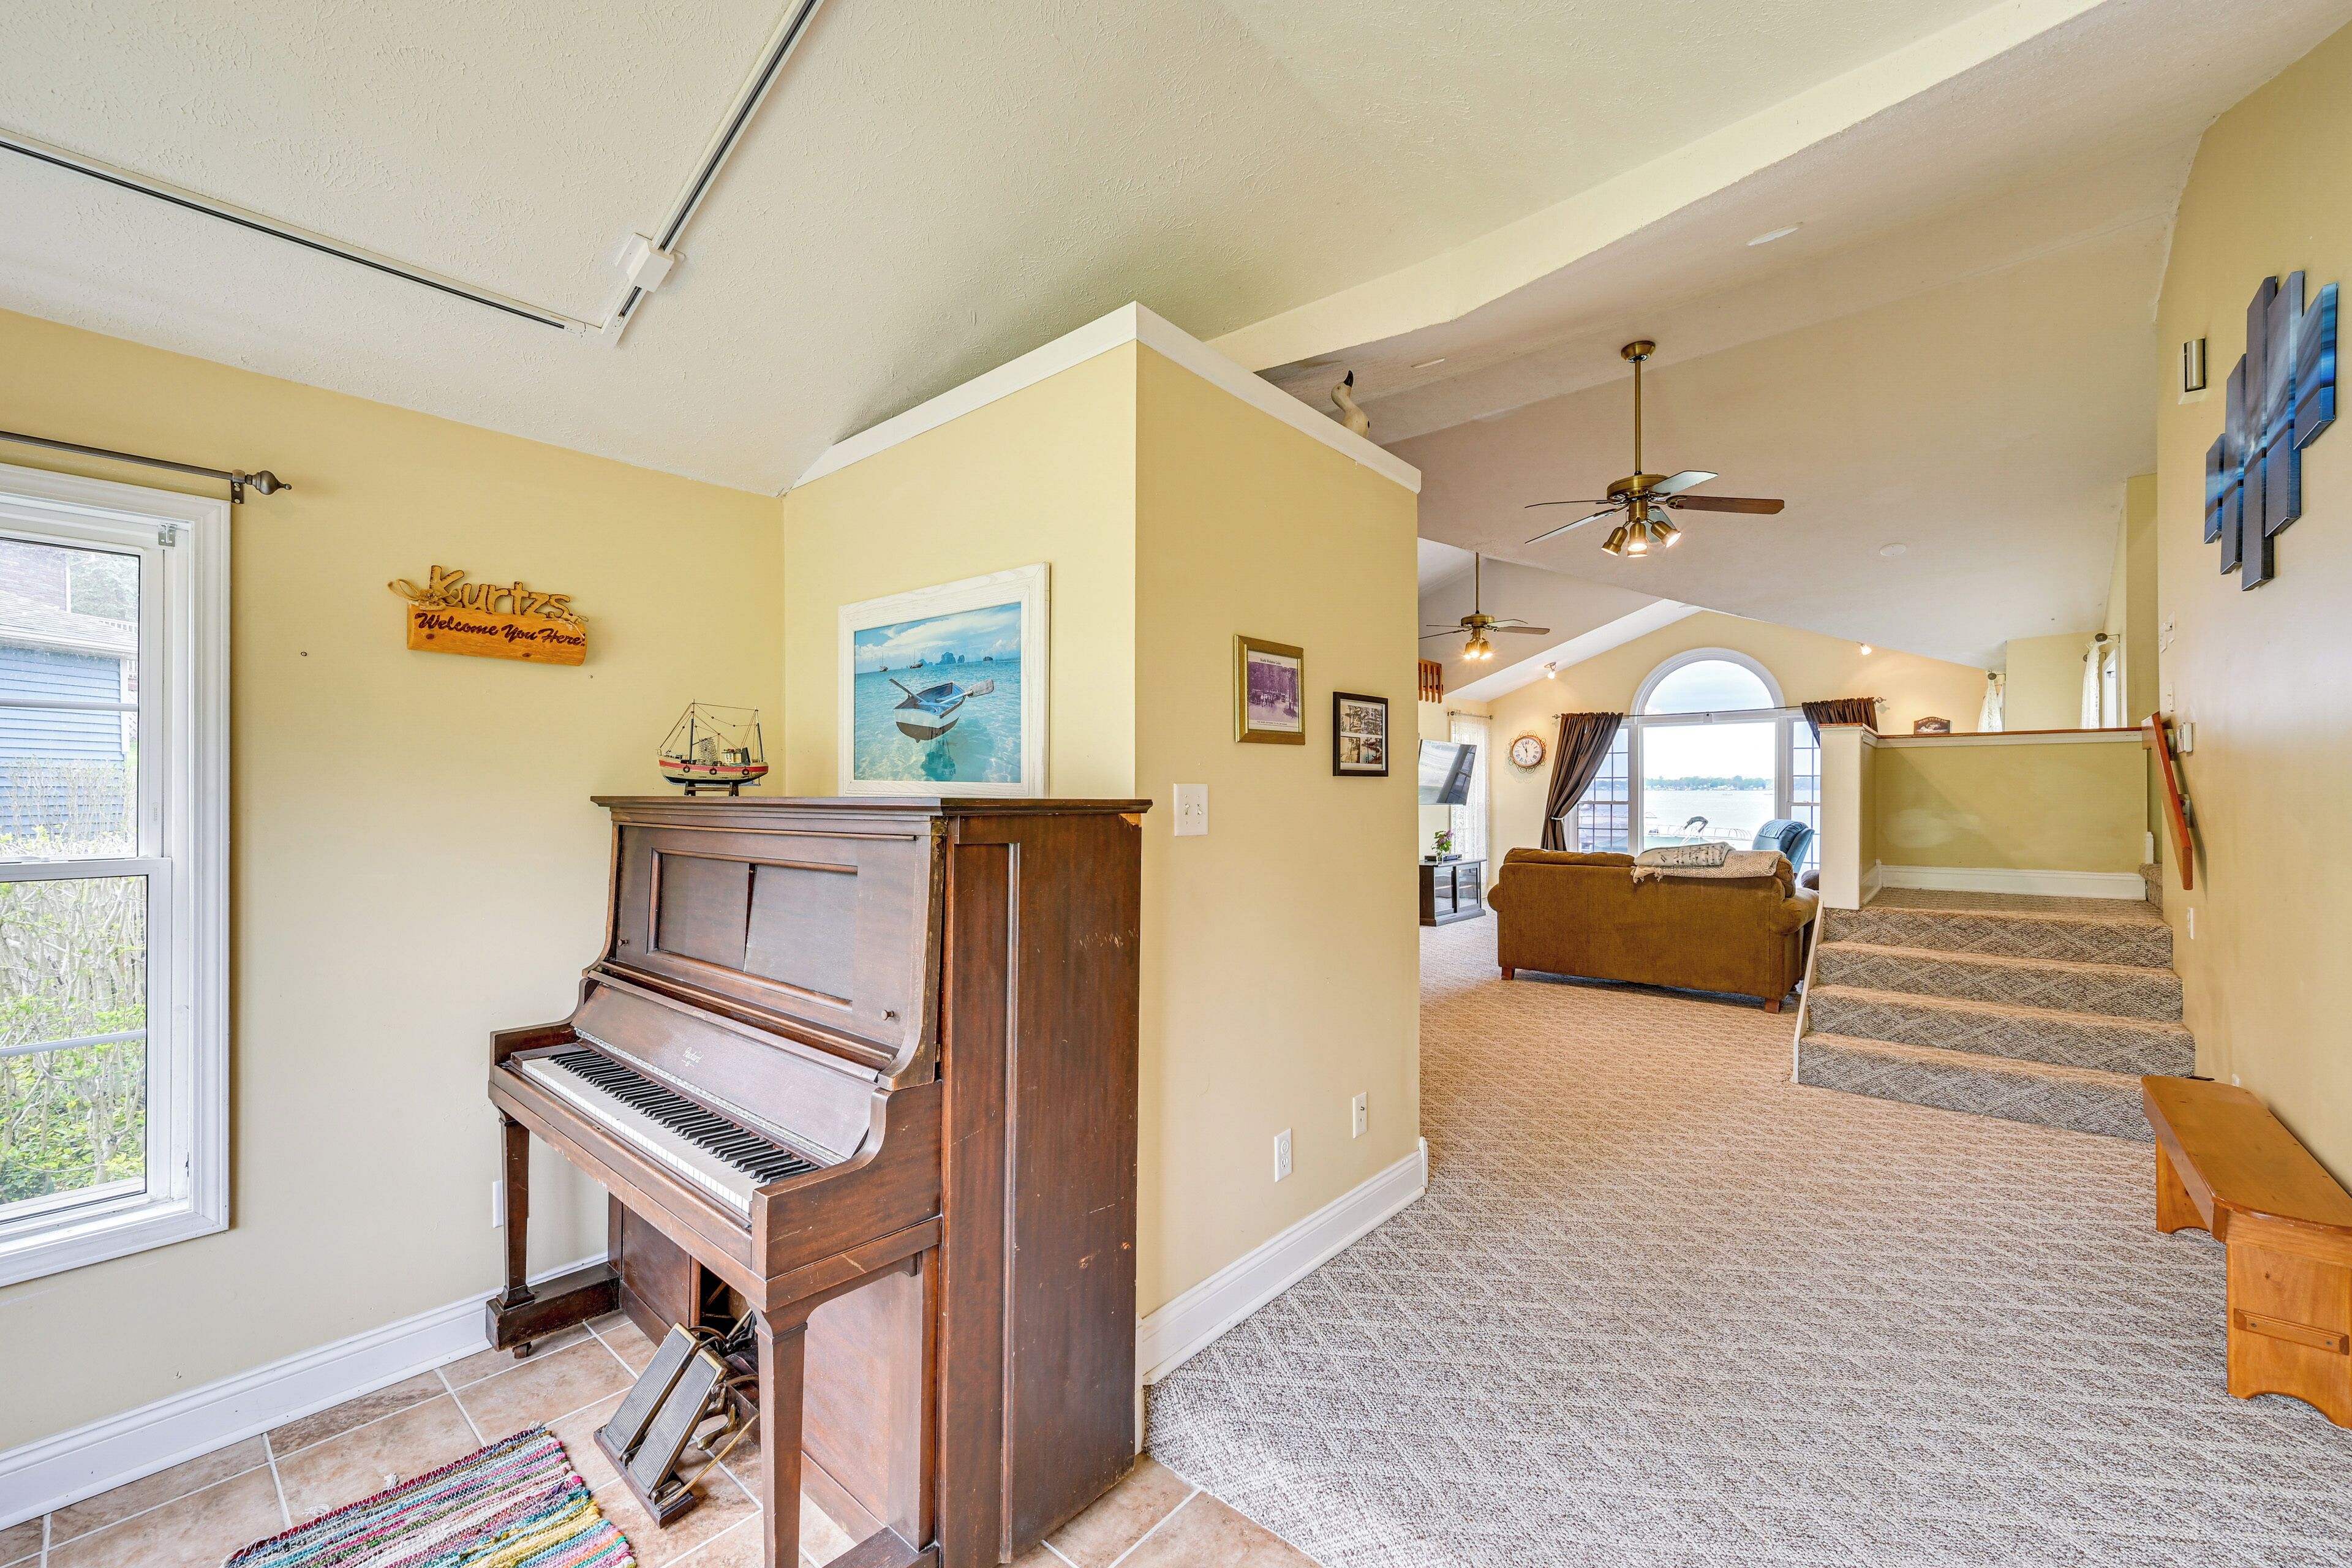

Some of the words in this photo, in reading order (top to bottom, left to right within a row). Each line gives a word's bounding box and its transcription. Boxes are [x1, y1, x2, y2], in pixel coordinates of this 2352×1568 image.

[414, 612, 499, 636] Welcome
[501, 624, 538, 643] You
[537, 628, 586, 647] Here!
[682, 1047, 704, 1063] Packard
